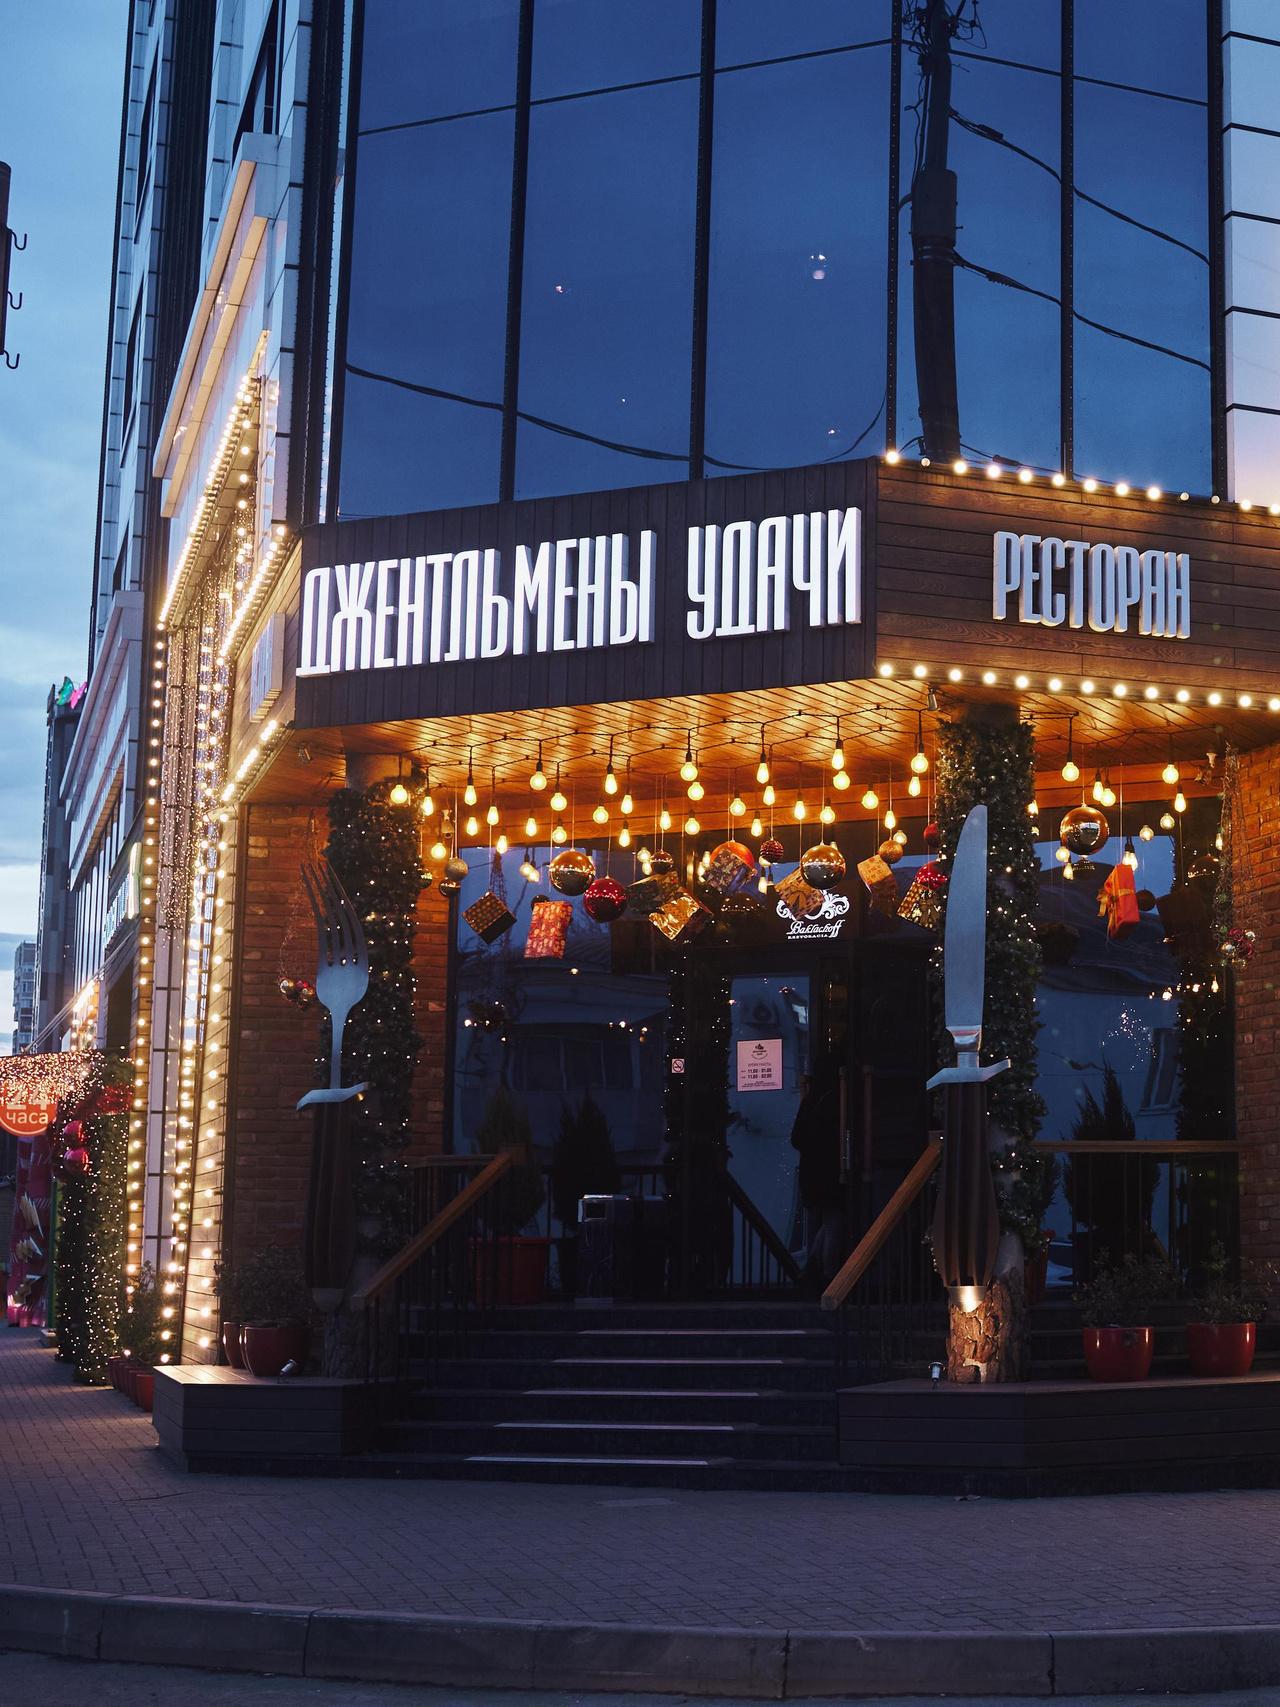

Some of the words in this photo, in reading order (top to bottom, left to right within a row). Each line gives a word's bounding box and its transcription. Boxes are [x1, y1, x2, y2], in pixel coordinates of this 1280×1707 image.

[296, 530, 657, 677] ДЖЕНТЛЬМЕНЫ
[686, 507, 862, 641] УДАЧИ
[993, 531, 1190, 640] РЕСТОРАН
[6, 1083, 51, 1110] 24
[6, 1112, 49, 1124] часа
